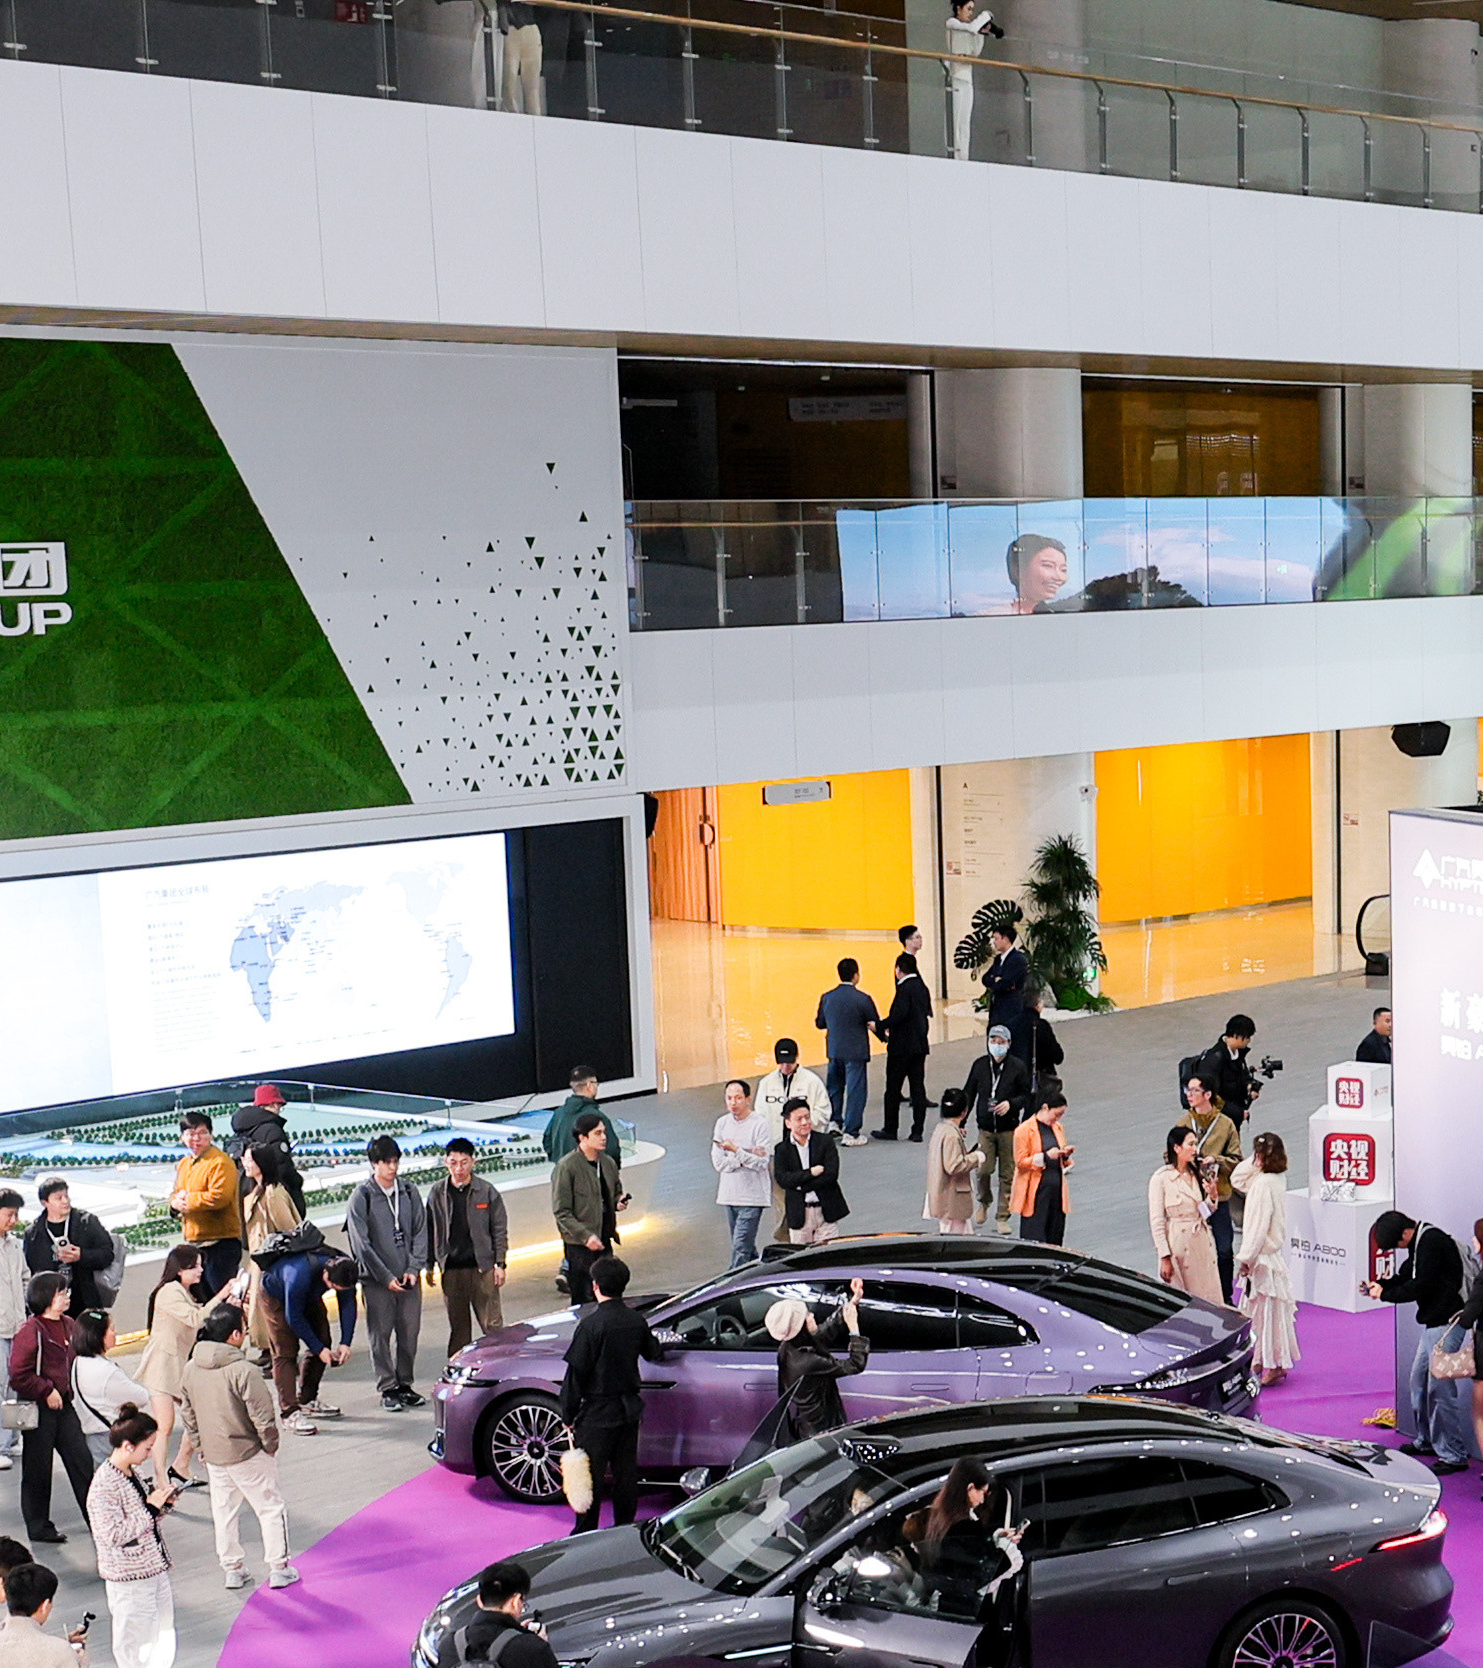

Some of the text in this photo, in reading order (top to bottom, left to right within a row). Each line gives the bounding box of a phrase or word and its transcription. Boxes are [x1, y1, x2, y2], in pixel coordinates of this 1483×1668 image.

[1338, 1080, 1361, 1093] 央视
[1338, 1092, 1361, 1106] 财经
[1329, 1138, 1369, 1160] 央视
[1329, 1159, 1370, 1180] 财经
